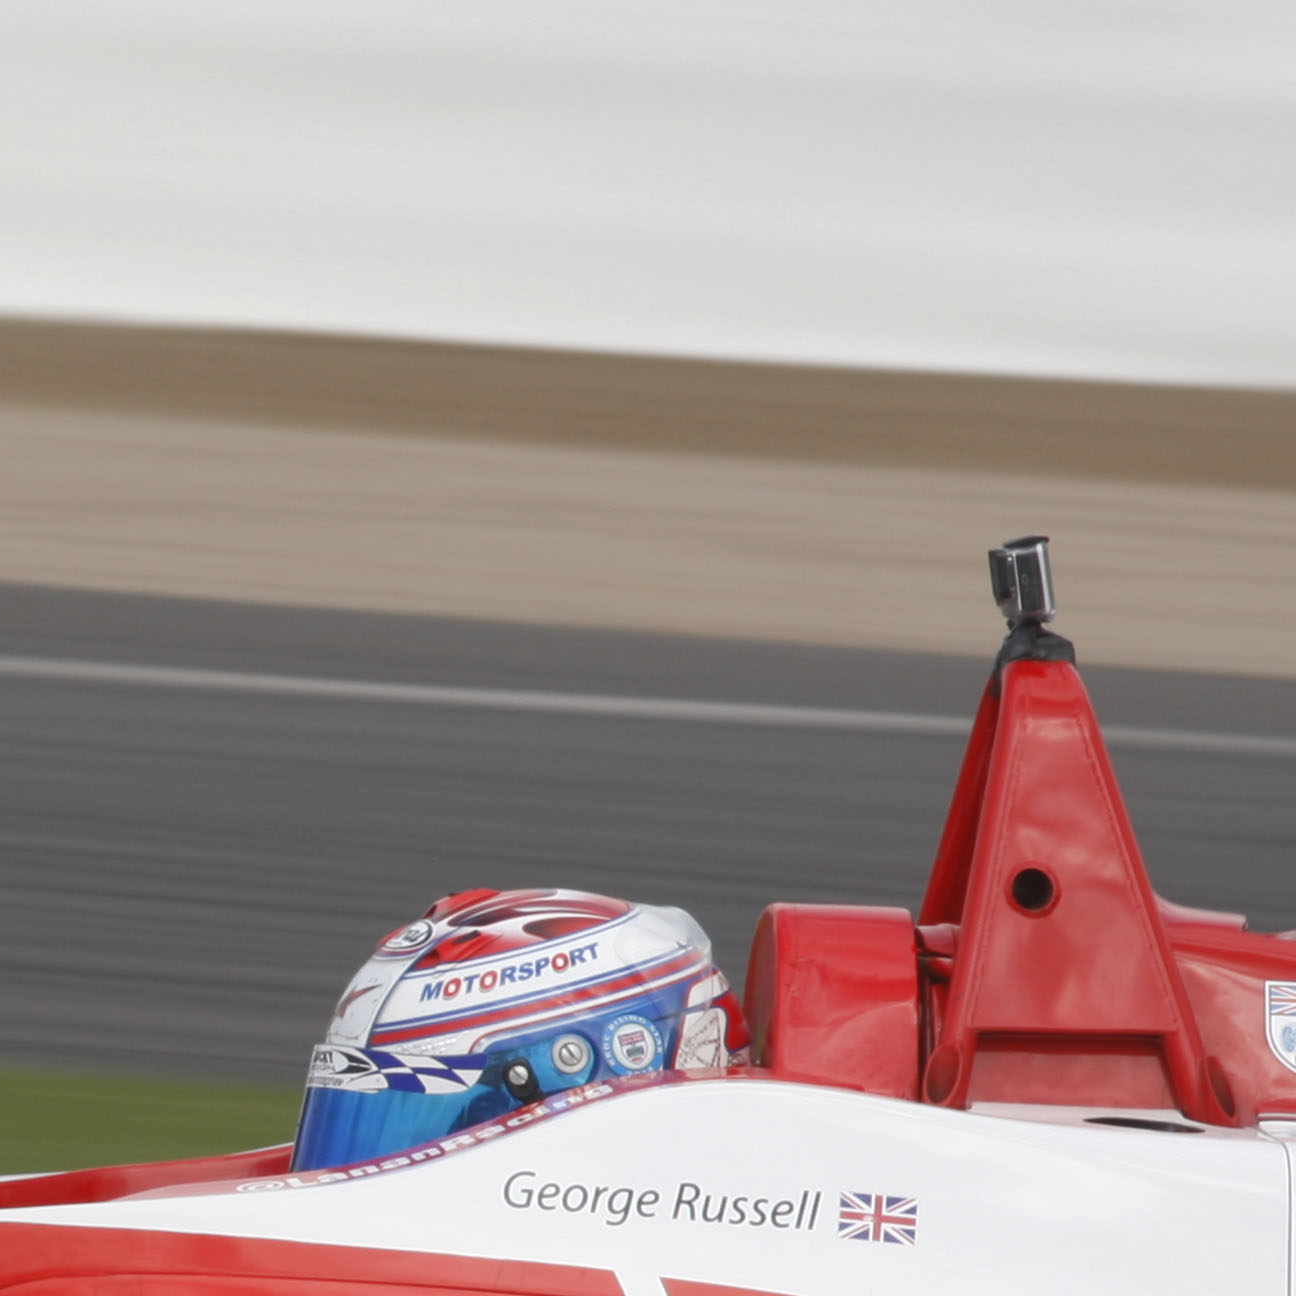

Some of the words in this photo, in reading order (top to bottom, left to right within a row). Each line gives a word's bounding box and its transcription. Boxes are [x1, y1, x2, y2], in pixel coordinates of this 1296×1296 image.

[420, 943, 600, 1002] MOTORSPORT
[502, 1170, 660, 1226] George
[672, 1182, 822, 1231] Russell
